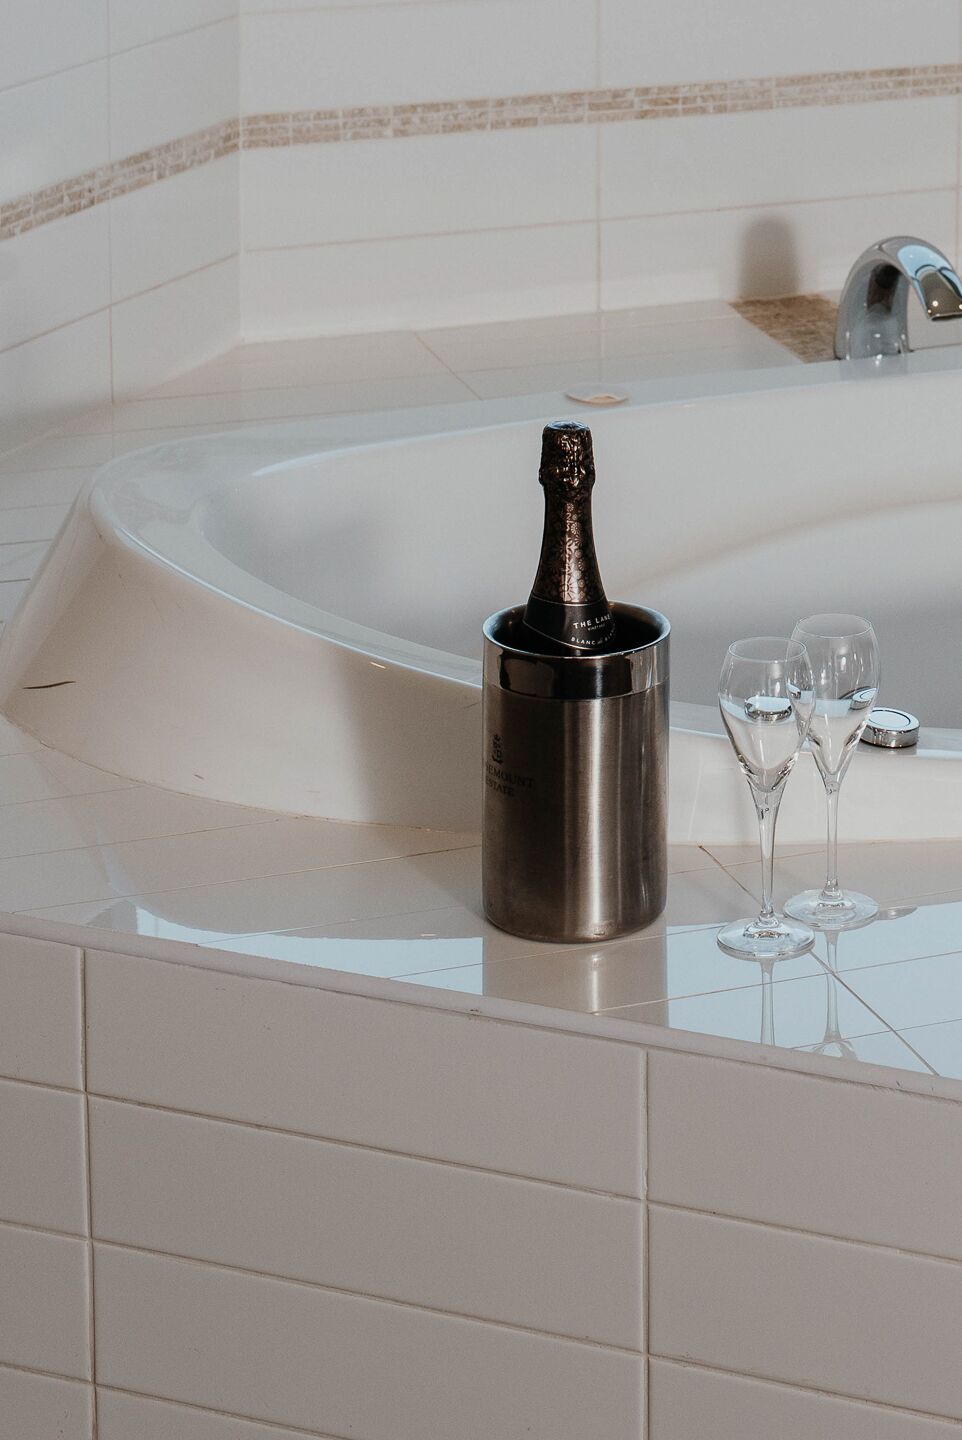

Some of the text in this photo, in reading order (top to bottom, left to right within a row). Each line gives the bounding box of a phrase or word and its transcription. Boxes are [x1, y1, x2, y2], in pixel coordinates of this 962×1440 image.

[573, 619, 592, 629] THE
[595, 614, 611, 623] LANE
[571, 637, 596, 645] BLANC
[486, 762, 535, 788] EMOUNT
